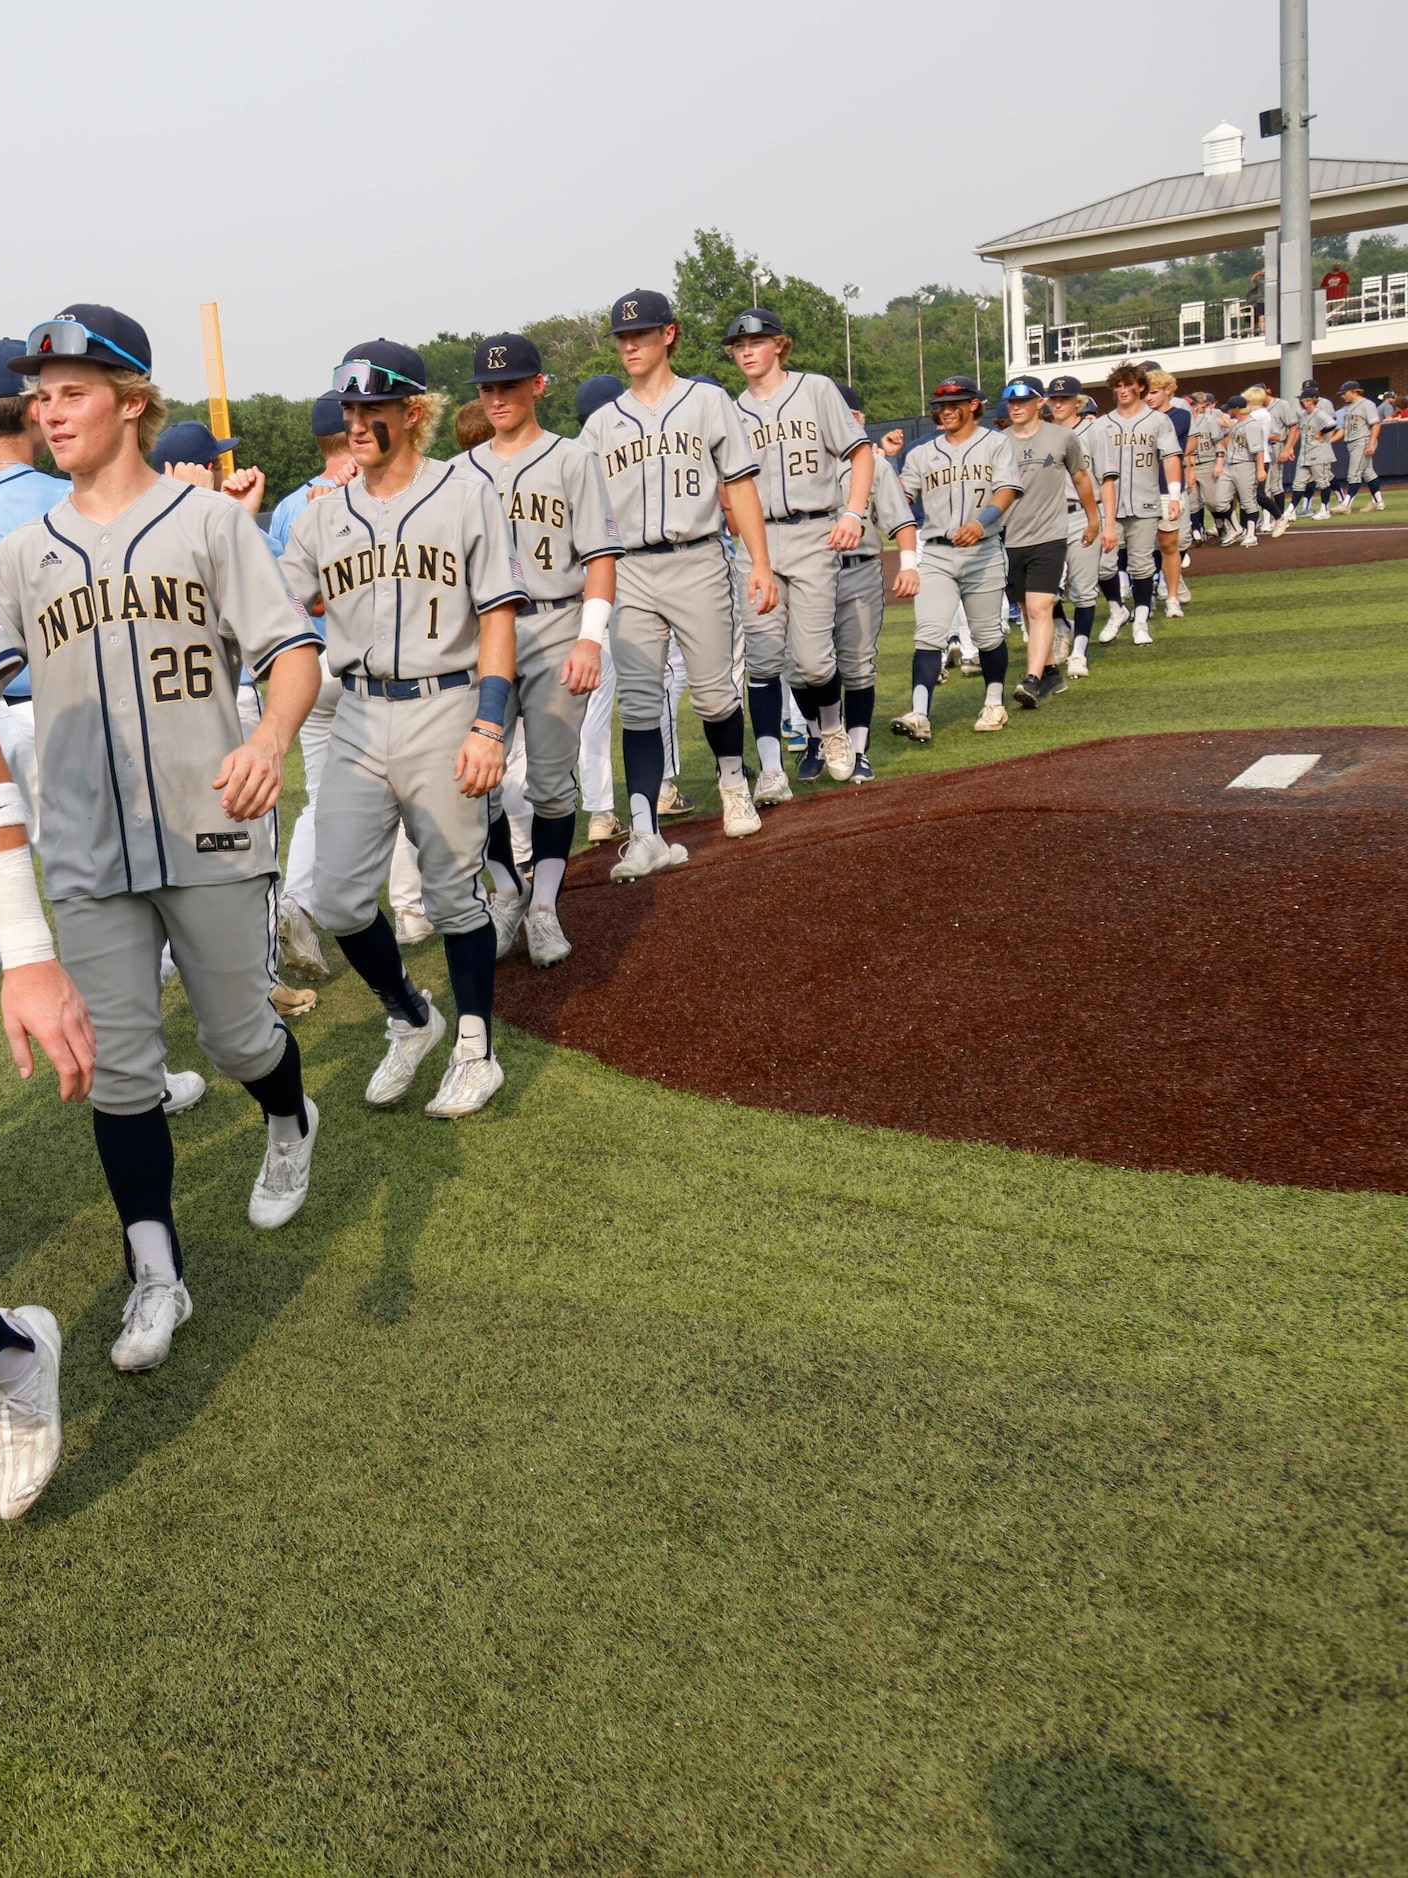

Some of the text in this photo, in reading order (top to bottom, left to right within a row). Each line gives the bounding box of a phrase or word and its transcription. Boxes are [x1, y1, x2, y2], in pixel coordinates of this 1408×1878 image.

[622, 301, 638, 320] K
[488, 346, 507, 369] K
[750, 420, 818, 452] DIANS
[1114, 433, 1156, 448] DIANS
[605, 430, 703, 480] INDIANS
[788, 449, 820, 477] 25
[1135, 452, 1154, 468] 20
[673, 467, 702, 498] 18
[924, 464, 993, 492] INDIANS
[974, 488, 986, 508] 7
[40, 560, 62, 568] adidas
[534, 535, 554, 571] 4
[321, 541, 458, 601] INDIANS
[37, 573, 208, 660] INDIANS
[426, 596, 440, 641] 1
[150, 642, 214, 704] 26
